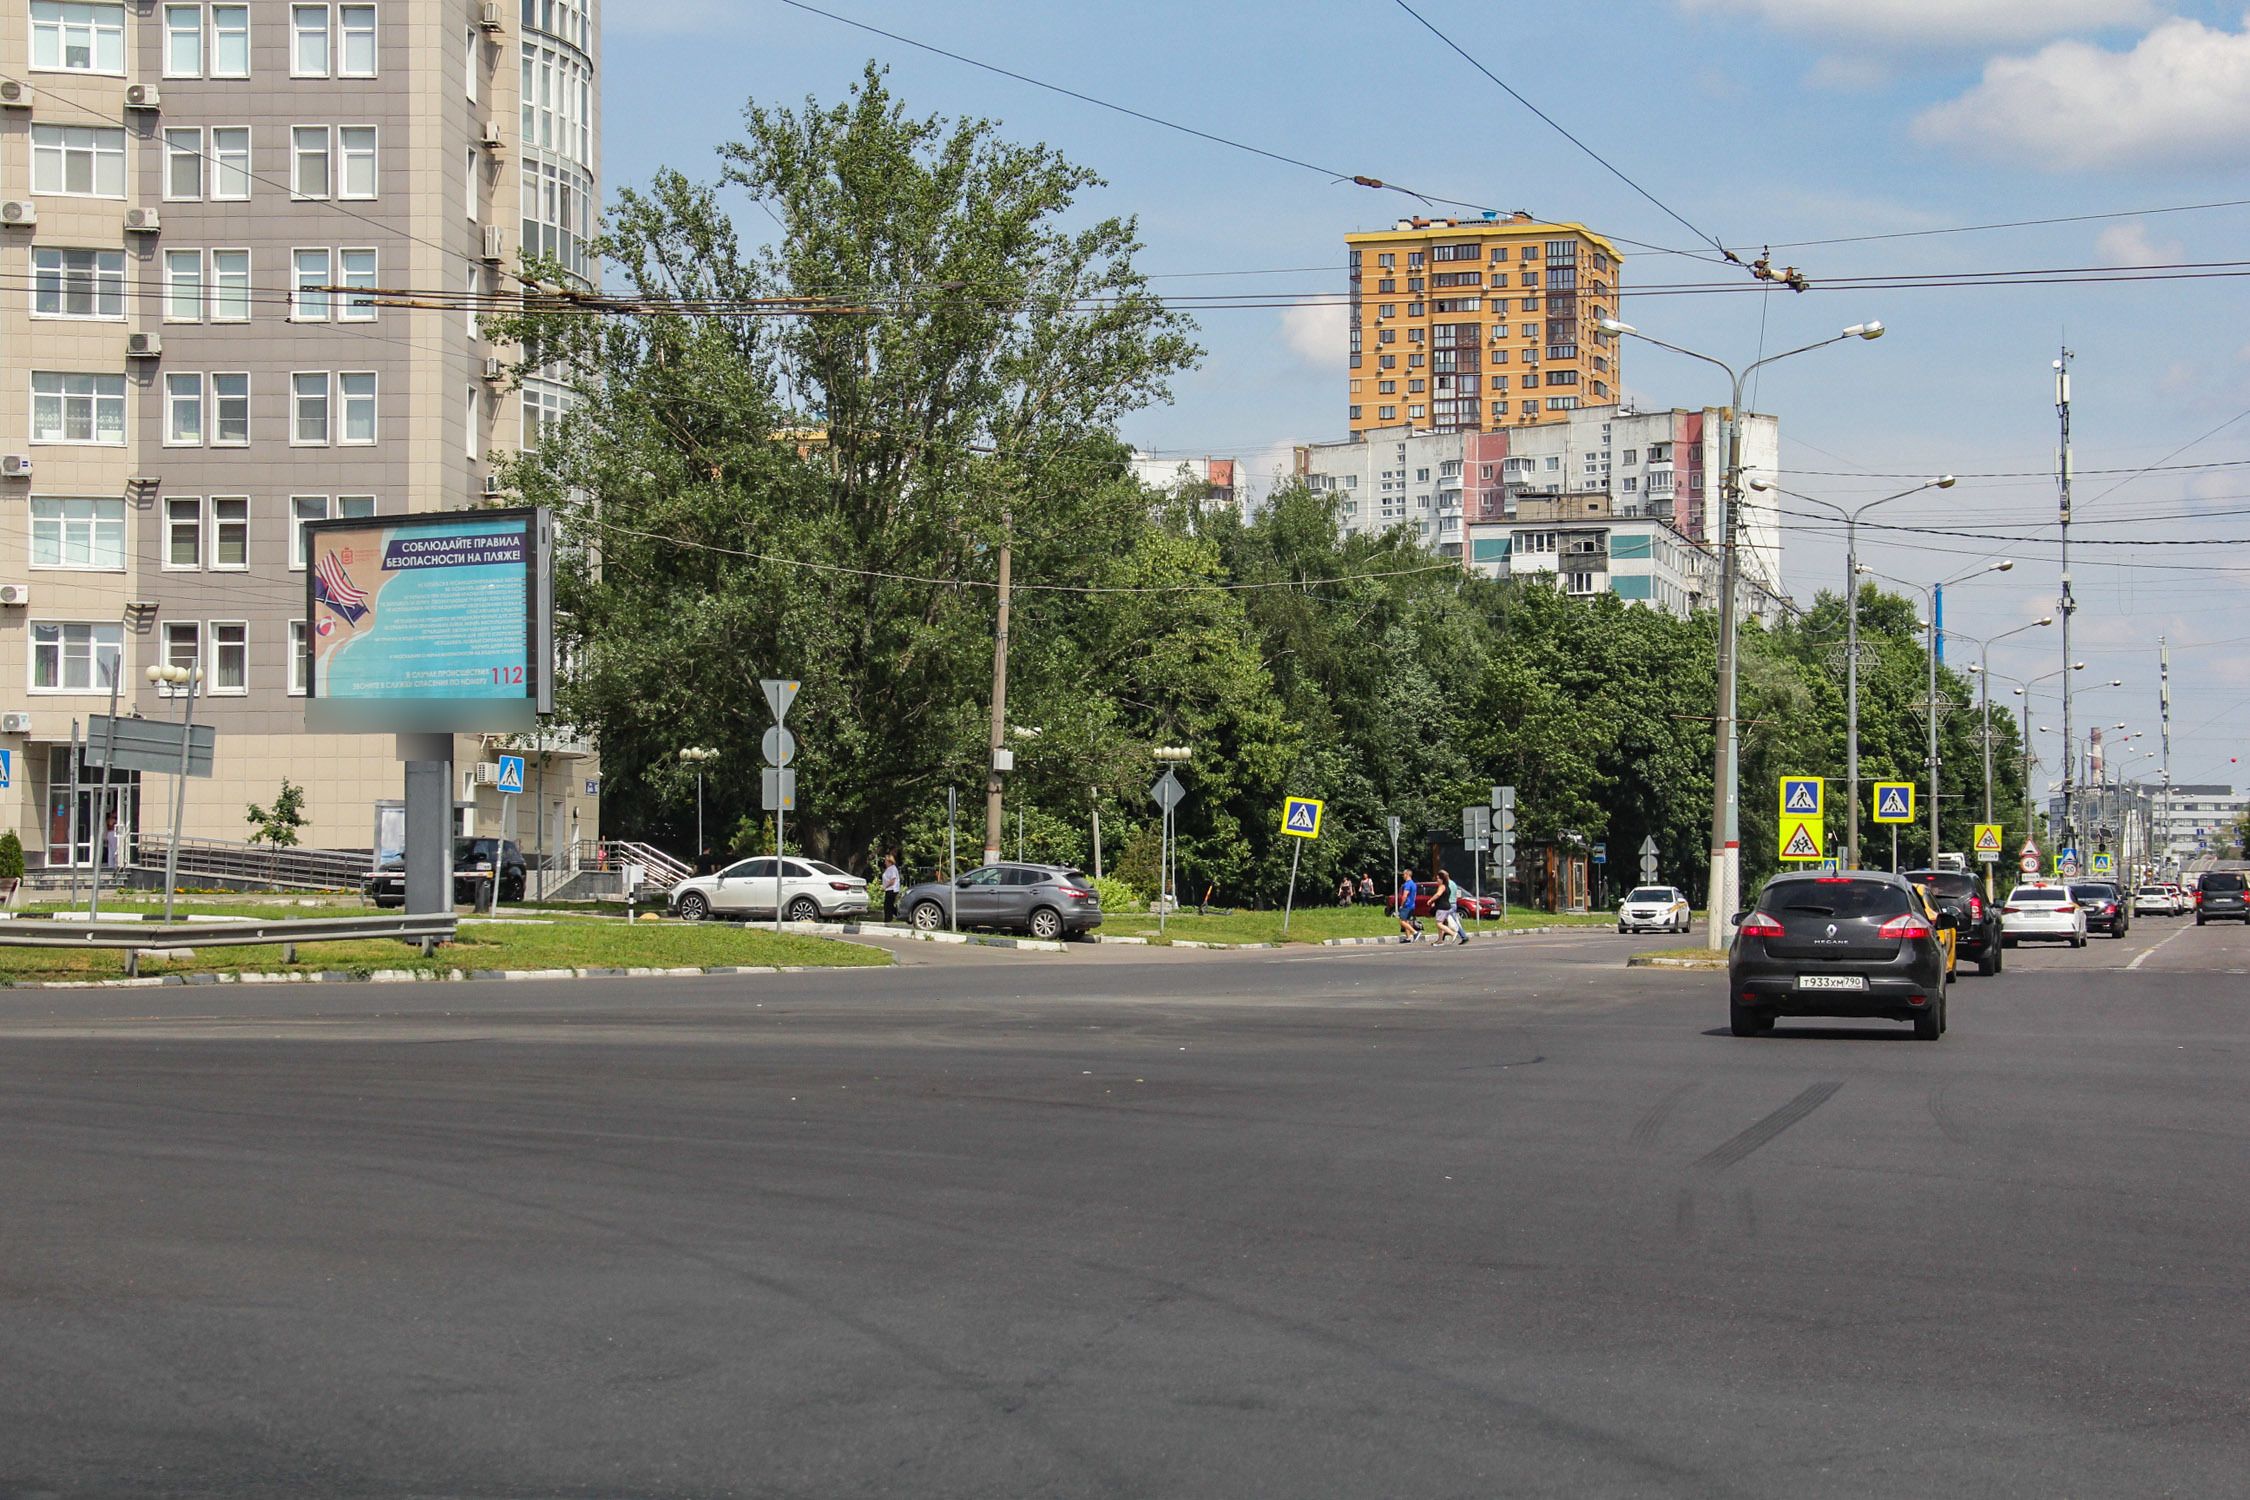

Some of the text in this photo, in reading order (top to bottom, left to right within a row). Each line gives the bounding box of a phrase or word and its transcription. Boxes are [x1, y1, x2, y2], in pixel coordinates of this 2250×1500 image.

[402, 536, 520, 553] СОБЛЮДАЙТЕ ПРАВИЛА
[386, 554, 465, 568] БЕЗОПАСНОСТИ
[467, 553, 482, 563] НА
[484, 550, 521, 562] ПЛЯЖЕ!
[449, 678, 459, 686] ПО
[491, 666, 523, 685] 112
[2024, 860, 2036, 868] 40
